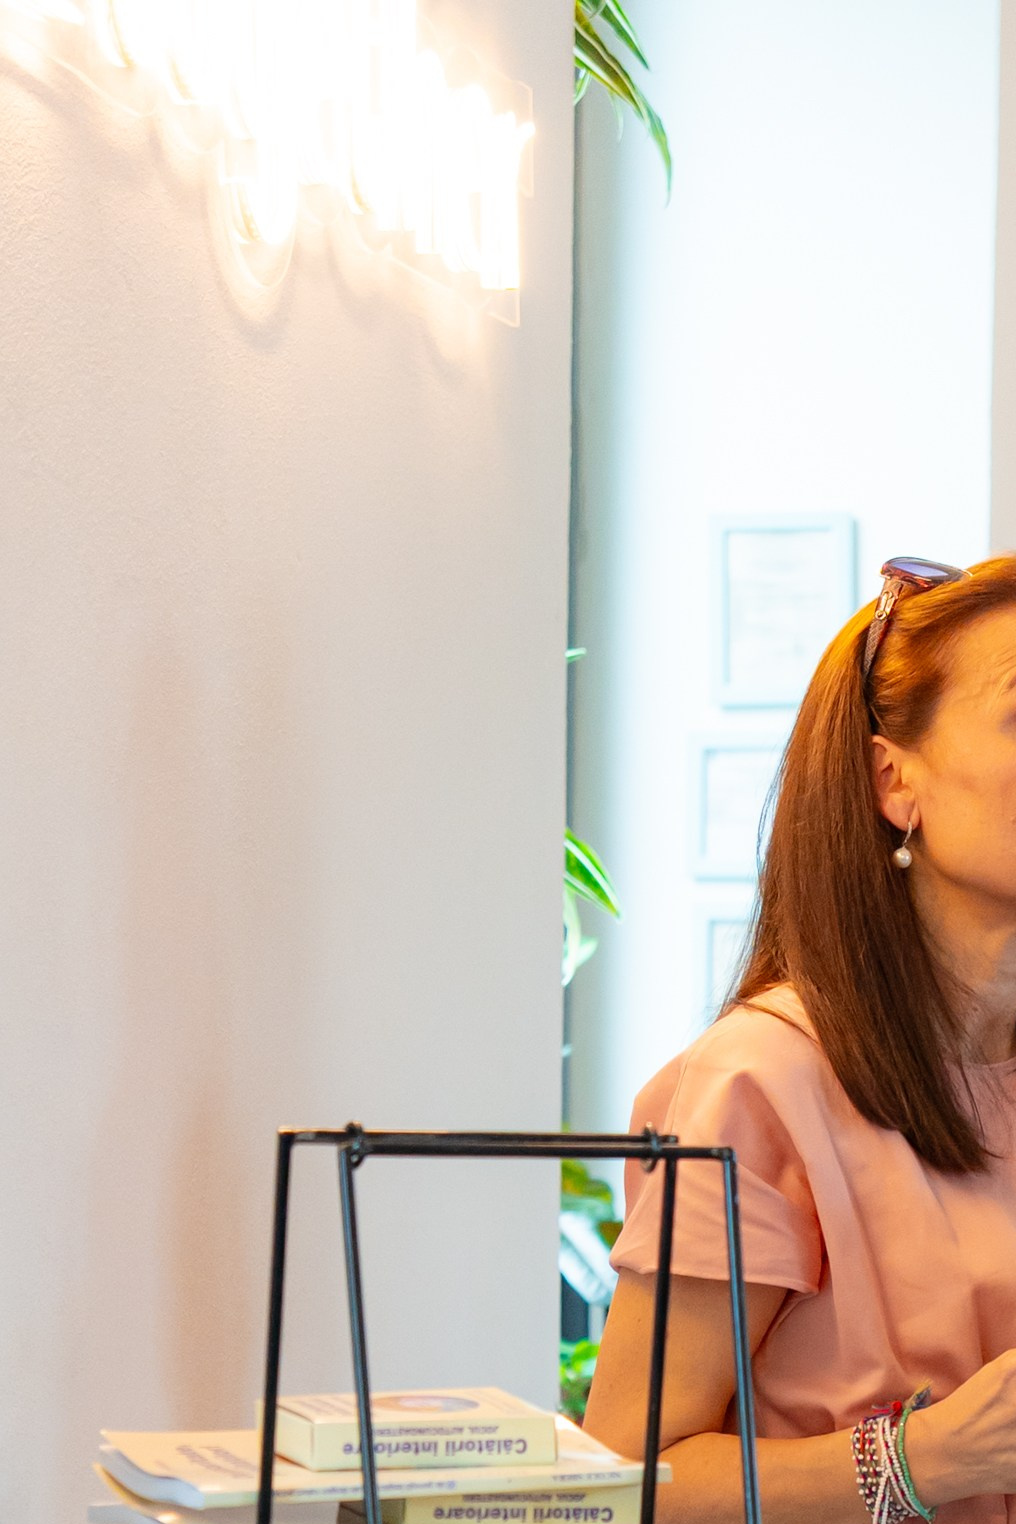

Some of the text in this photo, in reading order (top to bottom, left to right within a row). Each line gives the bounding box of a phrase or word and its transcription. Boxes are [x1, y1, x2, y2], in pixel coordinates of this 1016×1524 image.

[343, 1438, 528, 1458] Călătorii interiore
[433, 1507, 614, 1524] Călătorii interioare
